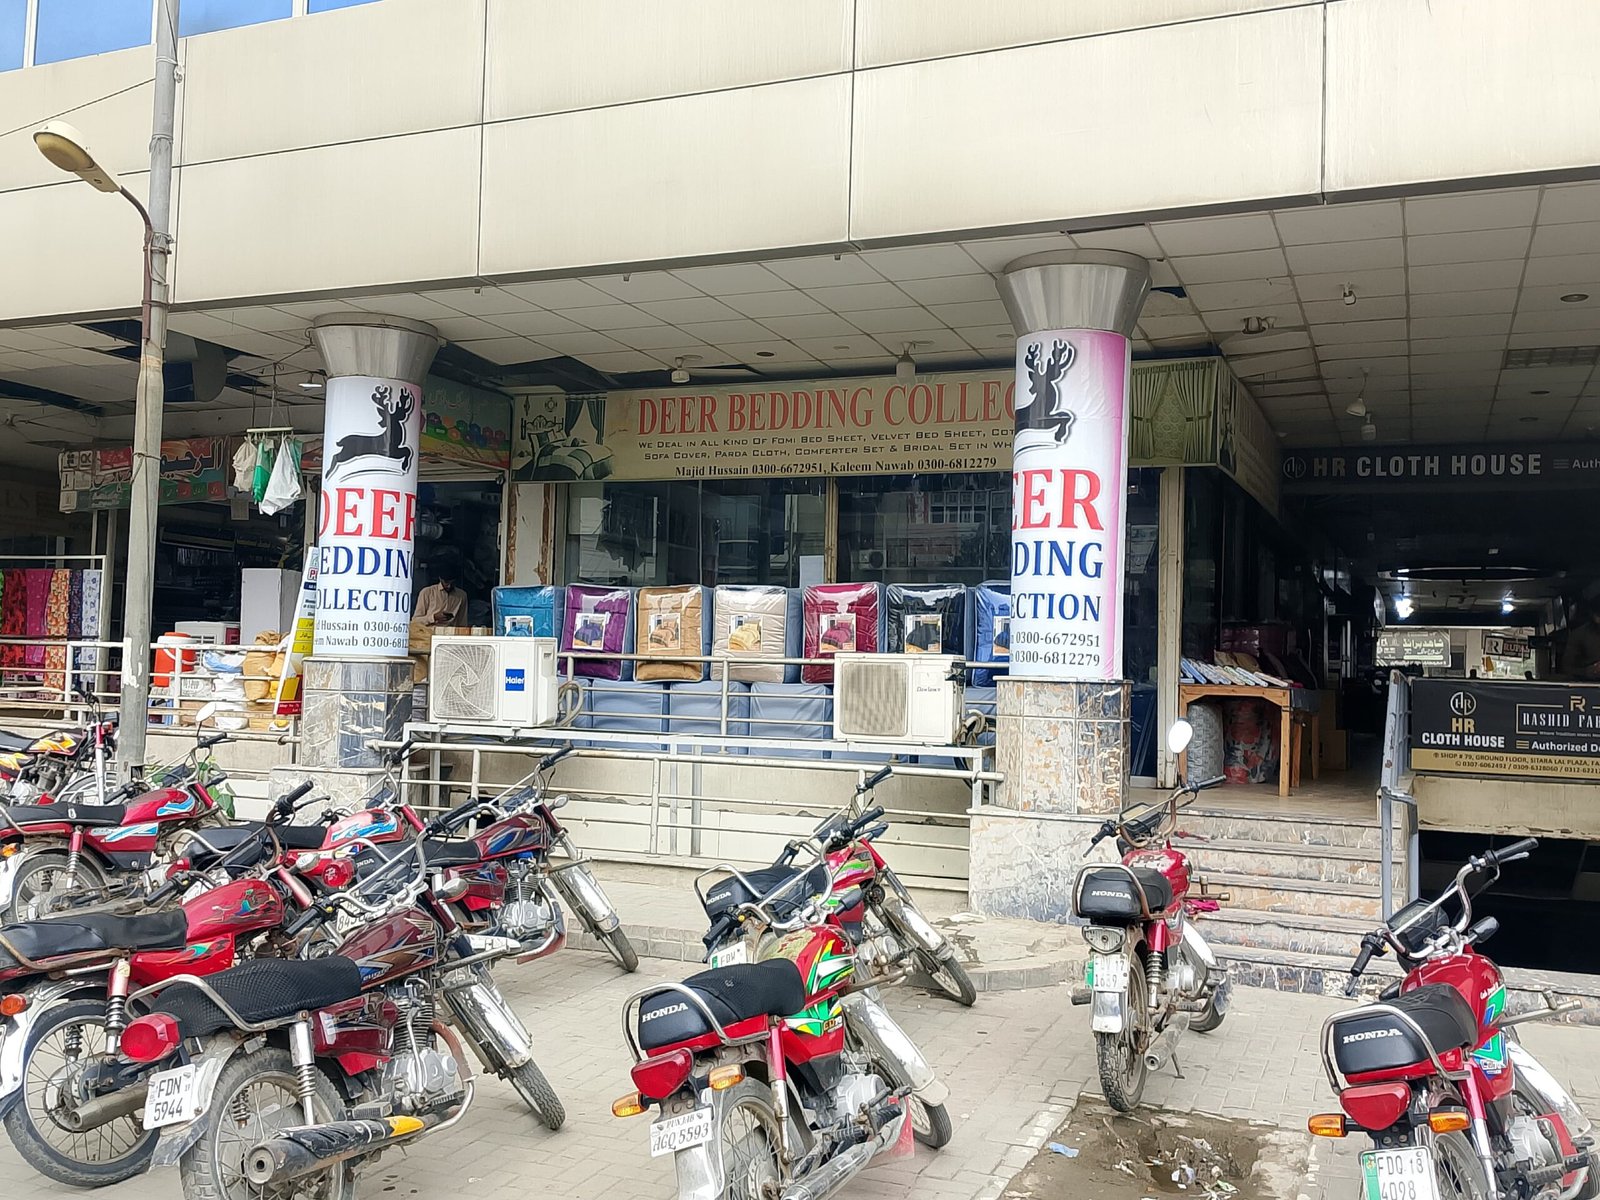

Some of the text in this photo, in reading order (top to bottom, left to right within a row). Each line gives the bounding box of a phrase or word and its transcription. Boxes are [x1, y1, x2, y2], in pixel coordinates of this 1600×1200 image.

[638, 395, 719, 435] DEER
[728, 386, 874, 432] BEDDING
[638, 441, 653, 449] WE
[657, 440, 682, 448] DEAL
[700, 439, 719, 447] ALL
[723, 438, 748, 446] KIND
[753, 437, 767, 445] OF
[801, 436, 822, 444] BED
[828, 434, 866, 443] SHEET,
[871, 433, 910, 441] VELVET
[916, 431, 939, 439] BED
[944, 429, 986, 438] SHEET,
[644, 452, 669, 460] SOFA
[674, 451, 710, 460] COVER,
[715, 450, 748, 458] PARDA
[752, 449, 790, 457] CLOTH,
[795, 446, 858, 456] COMFERTER
[904, 444, 944, 452] BRIDAL
[675, 465, 705, 479] Majid
[708, 464, 749, 476] Hussain
[830, 461, 872, 473] Kaleem
[875, 459, 914, 471] Nawab
[917, 457, 997, 470] 0300-6812279
[1313, 456, 1346, 477] HR
[1357, 455, 1440, 477] CLOTH
[1451, 454, 1542, 476] HOUSE
[320, 546, 414, 578] EDDIN
[1013, 540, 1103, 579] DING
[321, 619, 358, 631] Hussain
[326, 635, 358, 646] Nawab
[1016, 631, 1100, 648] 0300-6672951
[1015, 650, 1100, 667] 0300-6812279
[506, 676, 524, 684] Haier
[1452, 717, 1475, 733] HR
[1523, 712, 1570, 727] RASHID
[1422, 732, 1505, 748] CLOTH HOUSE
[1531, 741, 1588, 752] Authorized
[706, 891, 732, 905] HONDA
[1091, 890, 1131, 900] HONDA
[642, 1002, 688, 1023] HONDA
[1343, 1028, 1403, 1044] HONDA
[158, 1076, 182, 1098] FDN
[154, 1097, 183, 1121] 5944
[678, 1122, 709, 1145] 5593
